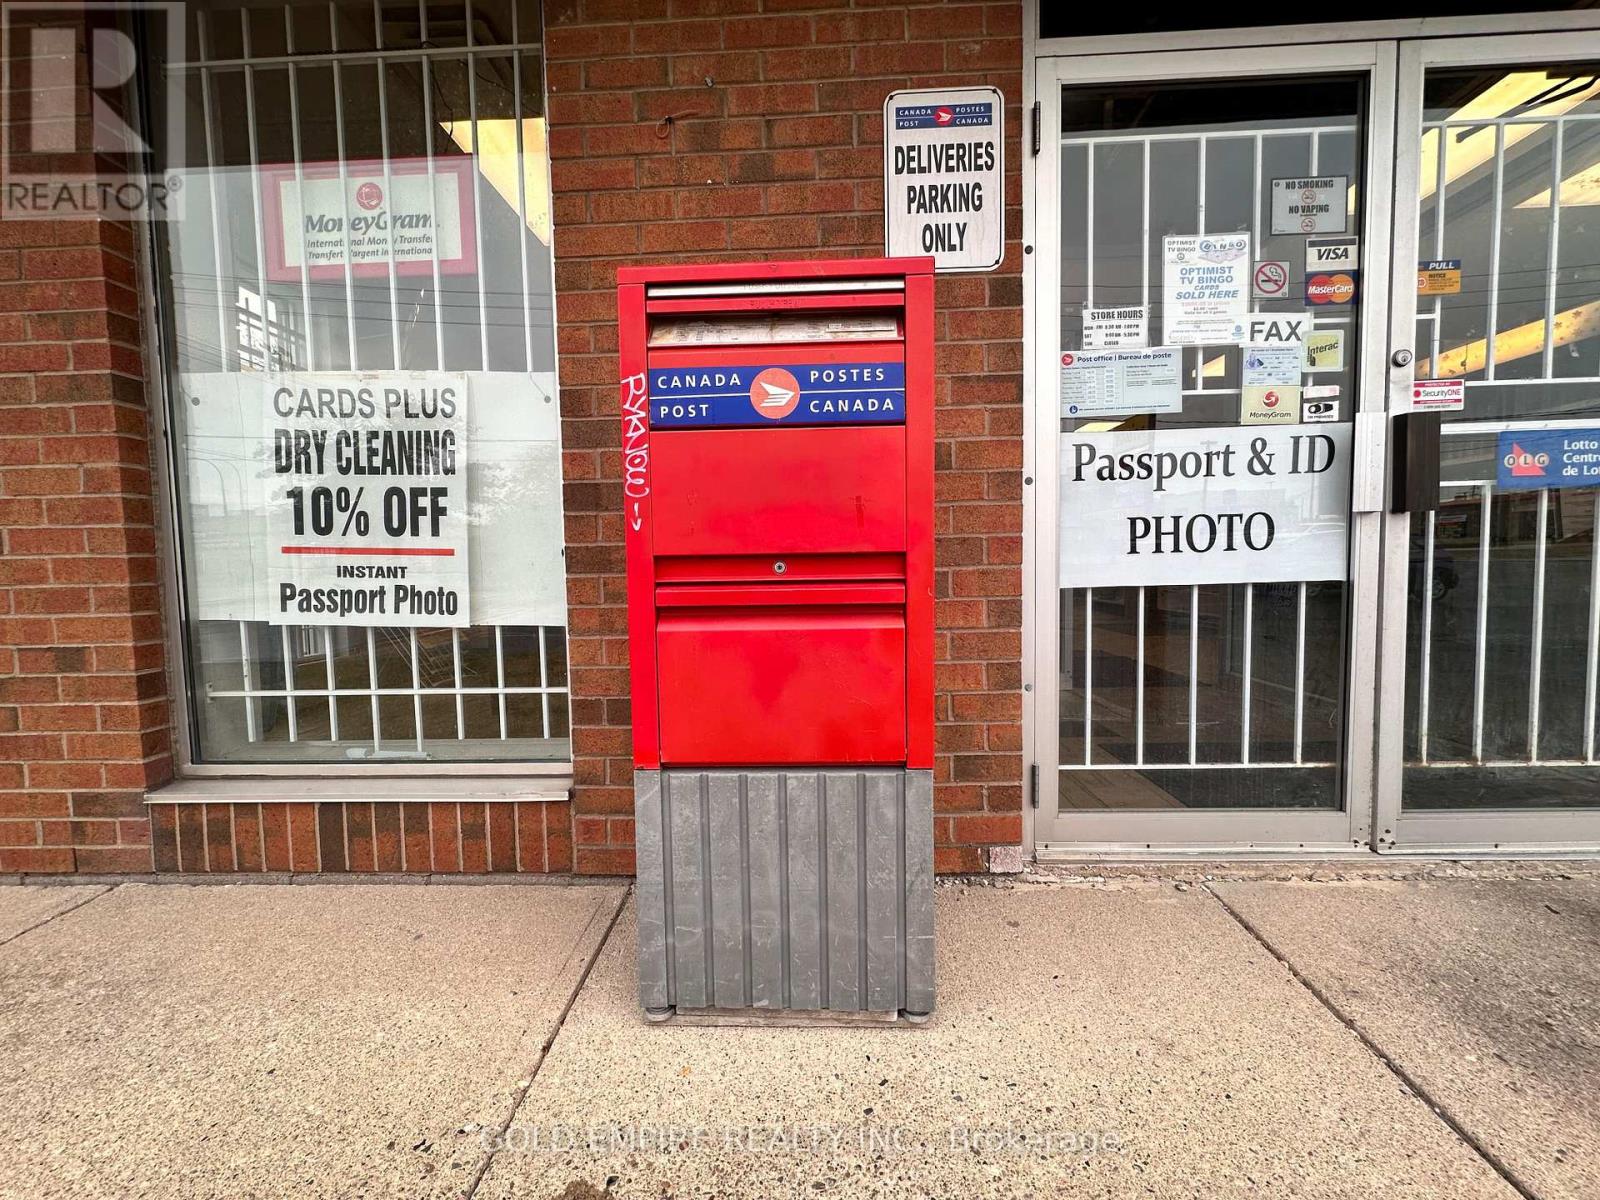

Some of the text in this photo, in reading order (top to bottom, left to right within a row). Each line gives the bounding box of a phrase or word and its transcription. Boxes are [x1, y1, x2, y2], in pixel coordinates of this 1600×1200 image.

[955, 117, 989, 125] CANADA
[894, 141, 995, 175] DELIVERIES
[1285, 179, 1334, 190] NO SMOKING
[906, 182, 983, 215] PARKING
[1288, 204, 1330, 215] NO VAPING
[921, 222, 968, 253] ONLY
[1316, 247, 1349, 261] VISA
[1180, 266, 1234, 276] OPTIMIST
[1428, 261, 1455, 270] PULL
[1180, 276, 1234, 285] TV BINGO
[1175, 290, 1239, 300] SOLD HERE
[1307, 284, 1354, 295] MasterCard
[1090, 310, 1144, 321] STORE HOURS
[1249, 320, 1302, 342] FAX
[1307, 342, 1339, 356] Interac
[1093, 354, 1113, 362] office
[1152, 352, 1172, 361] poste
[657, 368, 885, 389] CANADA POSTES
[1422, 388, 1461, 399] SecurityONE
[273, 387, 457, 419] CARDS PLUS
[660, 398, 894, 419] POST CANADA
[1249, 411, 1292, 419] MoneyGram
[1563, 439, 1599, 450] Lotto
[274, 428, 456, 476] DRY CLEANING
[1071, 434, 1336, 492] Passport & ID
[1504, 453, 1549, 467] OLG
[1562, 465, 1579, 477] de
[286, 486, 448, 538] 10% OFF
[1126, 511, 1276, 555] PHOTO
[336, 565, 408, 579] INSTANT
[279, 582, 458, 618] Passport Photo
